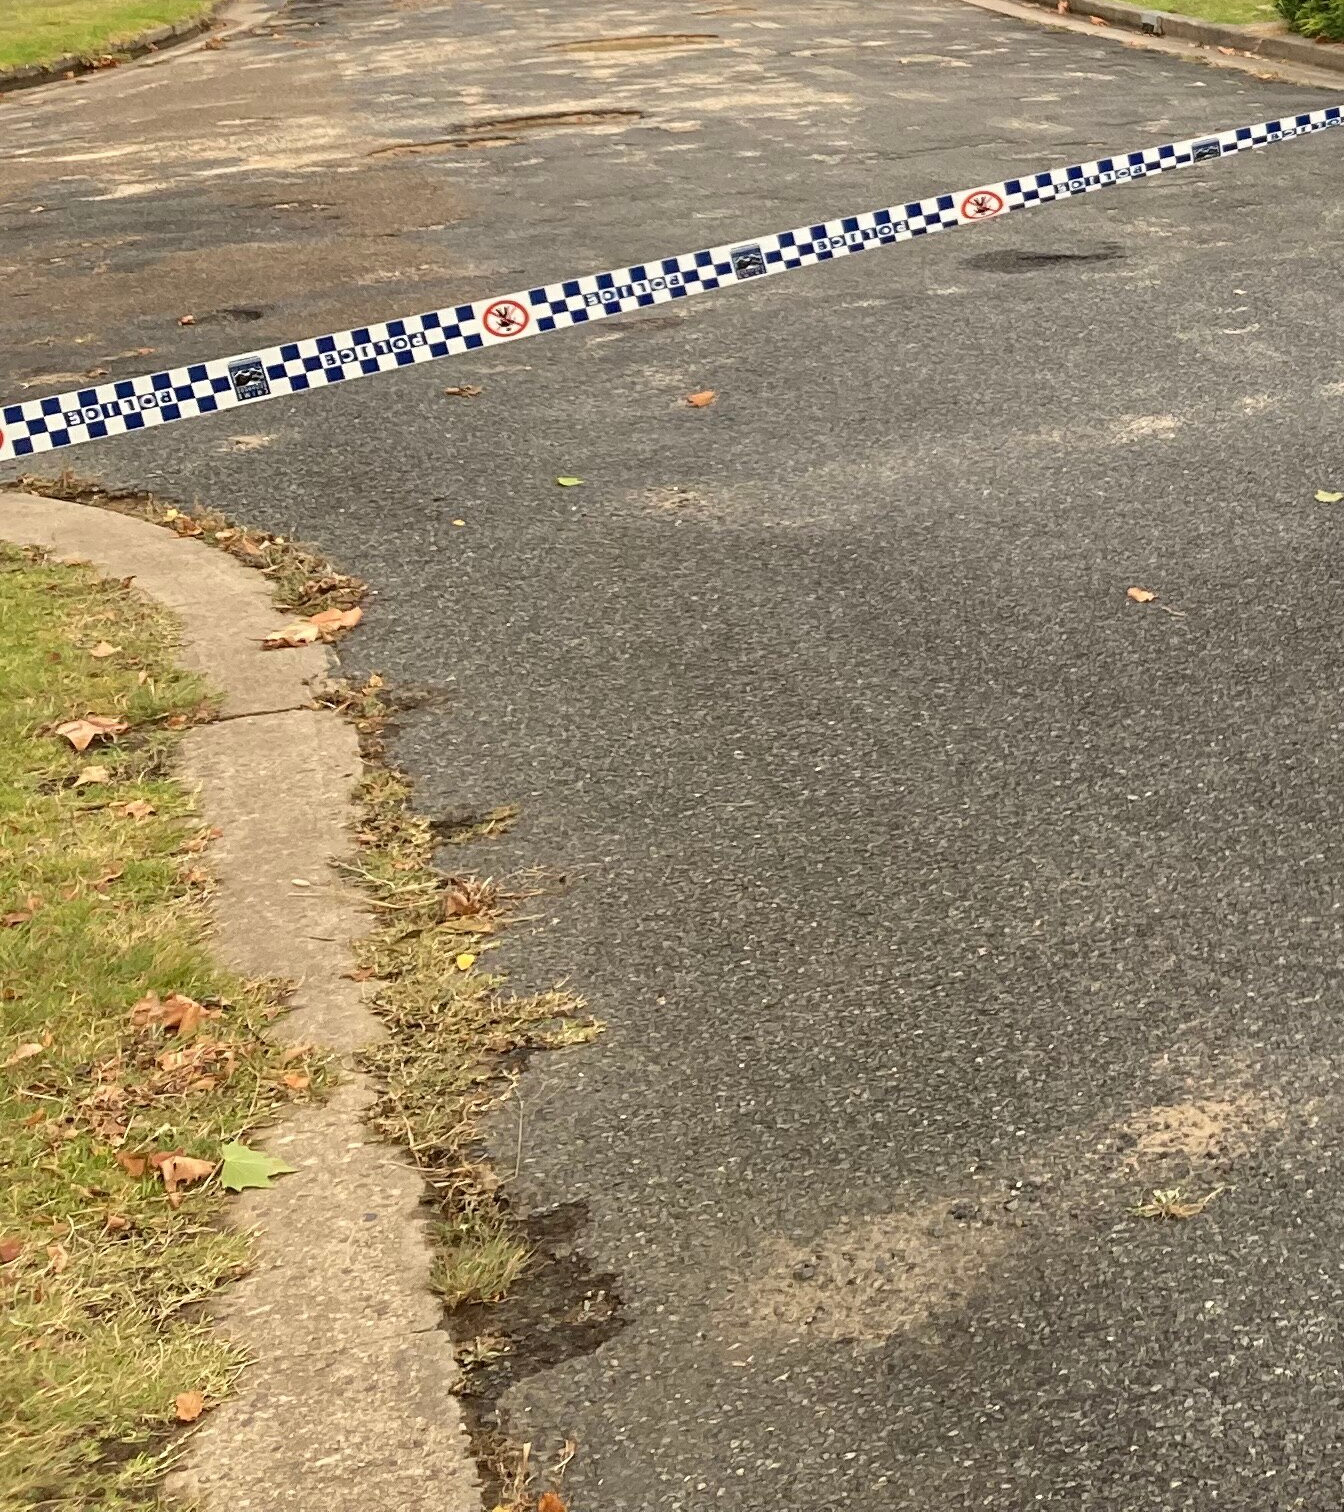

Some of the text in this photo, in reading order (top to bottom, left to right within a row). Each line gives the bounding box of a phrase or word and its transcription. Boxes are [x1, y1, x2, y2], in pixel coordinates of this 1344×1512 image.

[584, 273, 684, 308] POLICE
[322, 331, 427, 366] POLICE
[64, 390, 173, 428] POLICE
